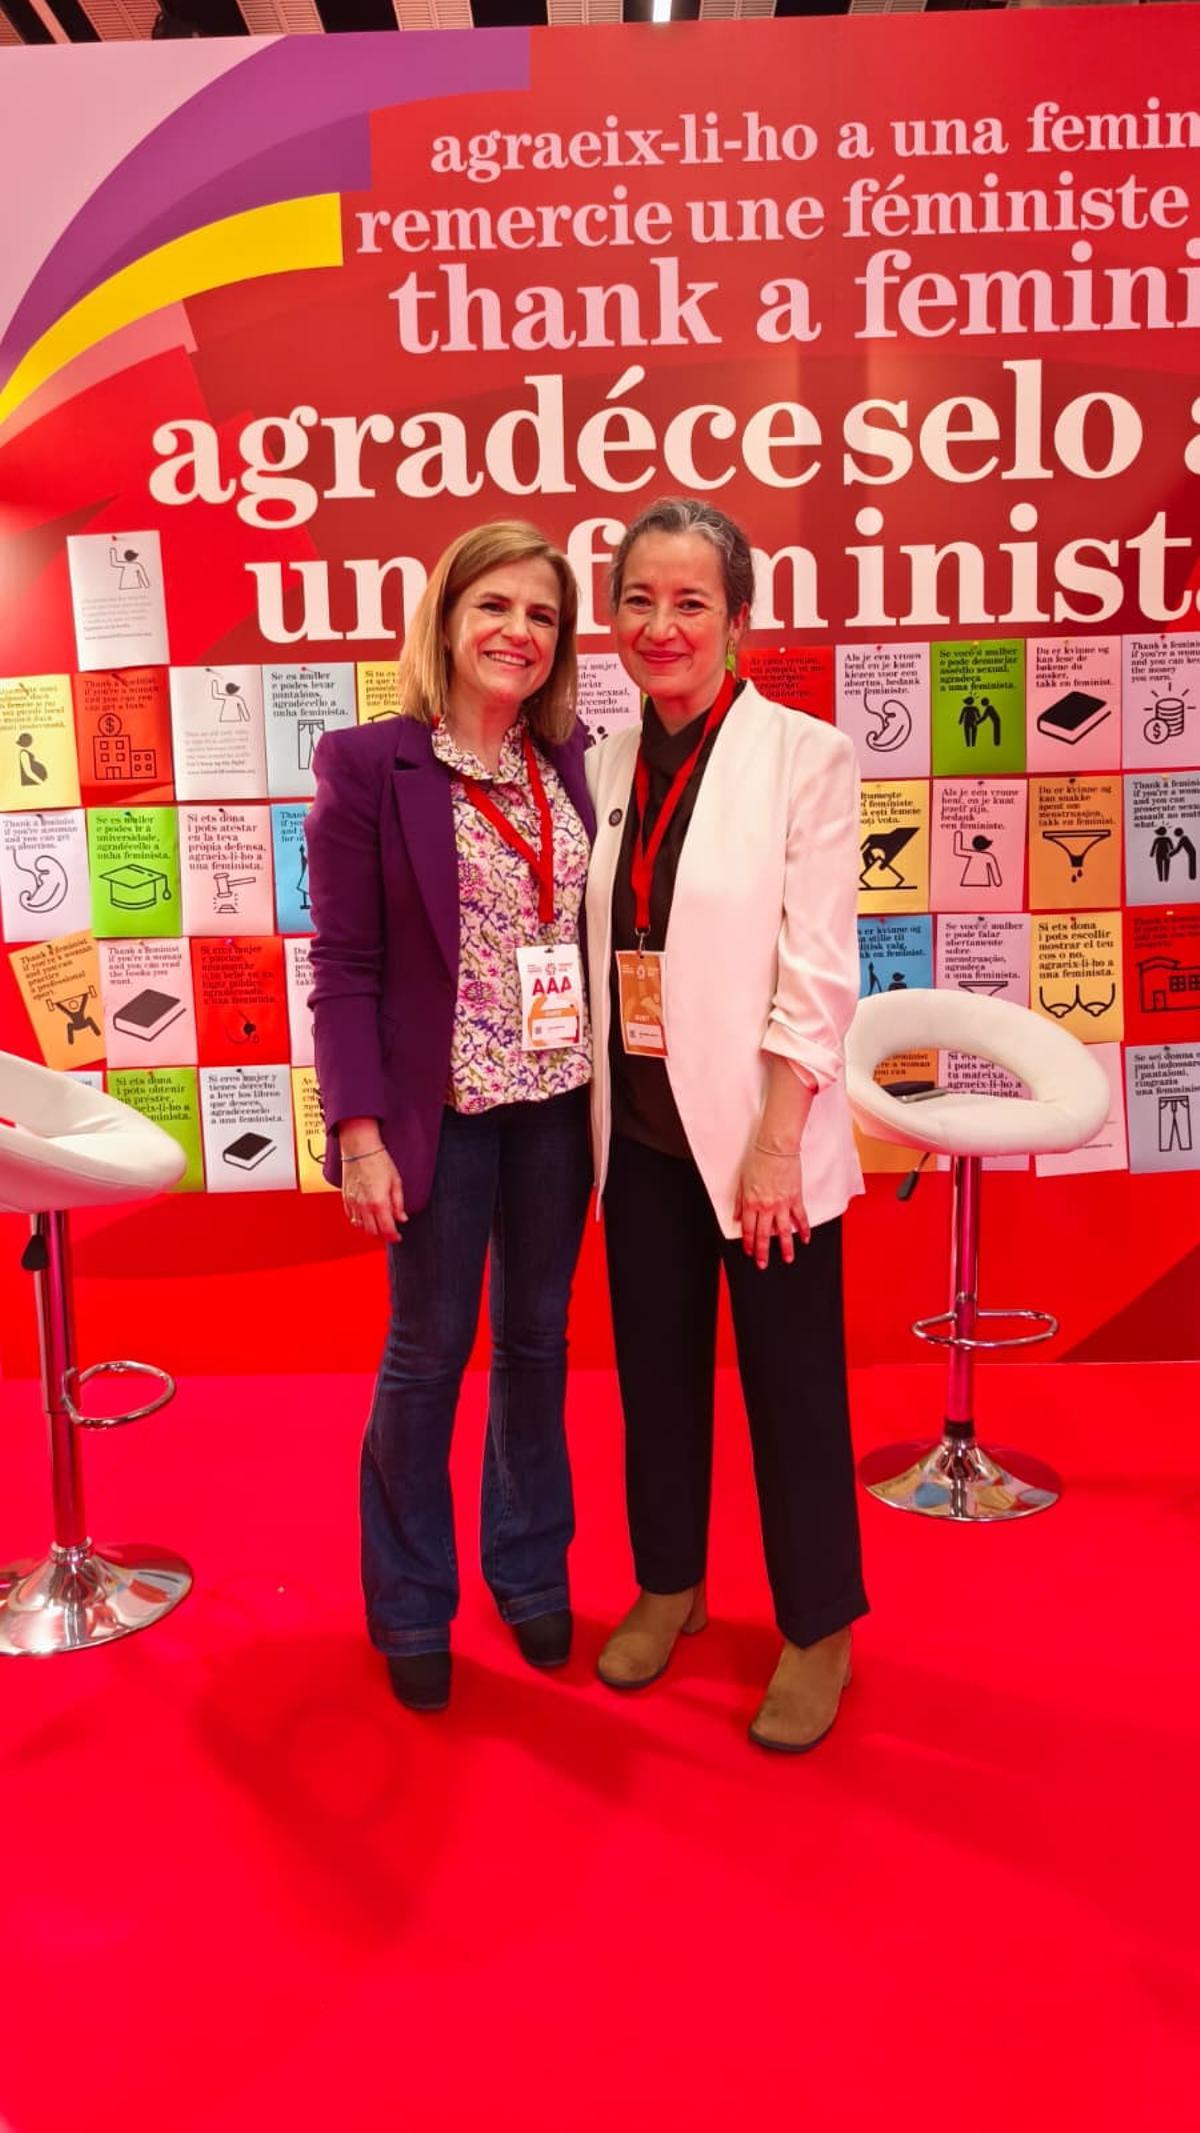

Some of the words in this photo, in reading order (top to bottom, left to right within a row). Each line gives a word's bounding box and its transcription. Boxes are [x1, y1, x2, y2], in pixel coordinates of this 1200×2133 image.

[431, 111, 818, 183] agraeix-li-ho
[837, 122, 874, 159] a
[890, 117, 1009, 157] una
[355, 185, 673, 253] remercie
[685, 196, 825, 243] une
[842, 170, 1189, 238] féministe
[388, 256, 722, 354] thank
[756, 278, 822, 343] a
[244, 554, 430, 644] un
[1051, 922, 1067, 930] ets
[1070, 921, 1096, 930] dona
[1038, 941, 1080, 950] mostrar
[1096, 940, 1113, 948] teu
[1044, 931, 1068, 943] pots
[1070, 930, 1110, 940] escollir
[1038, 959, 1104, 972] agraeix-li-ho
[532, 976, 572, 996] AAA
